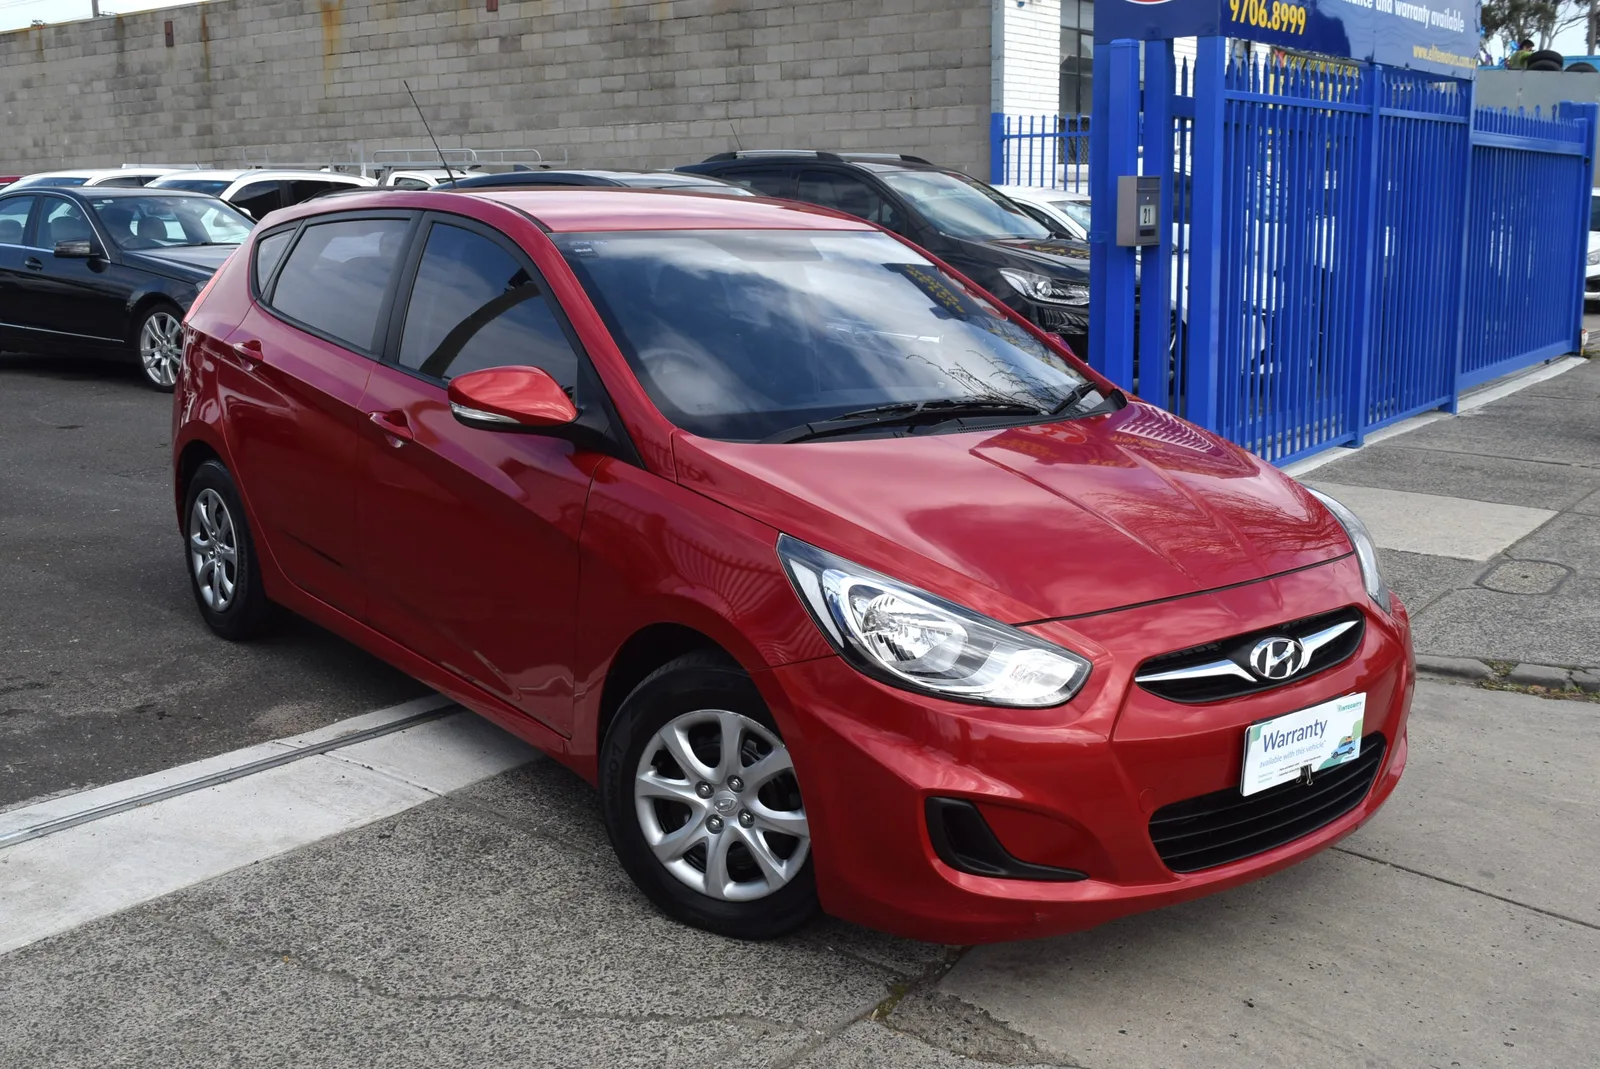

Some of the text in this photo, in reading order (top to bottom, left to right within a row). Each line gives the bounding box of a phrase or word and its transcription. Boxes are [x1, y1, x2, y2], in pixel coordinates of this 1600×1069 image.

[1229, 0, 1306, 35] 9706.8999
[1394, 0, 1430, 29] warranty
[1431, 7, 1465, 33] available
[1143, 207, 1151, 224] 21
[1263, 719, 1328, 752] Warranty
[1259, 754, 1283, 768] available
[1283, 750, 1295, 760] with
[1295, 747, 1306, 756] this
